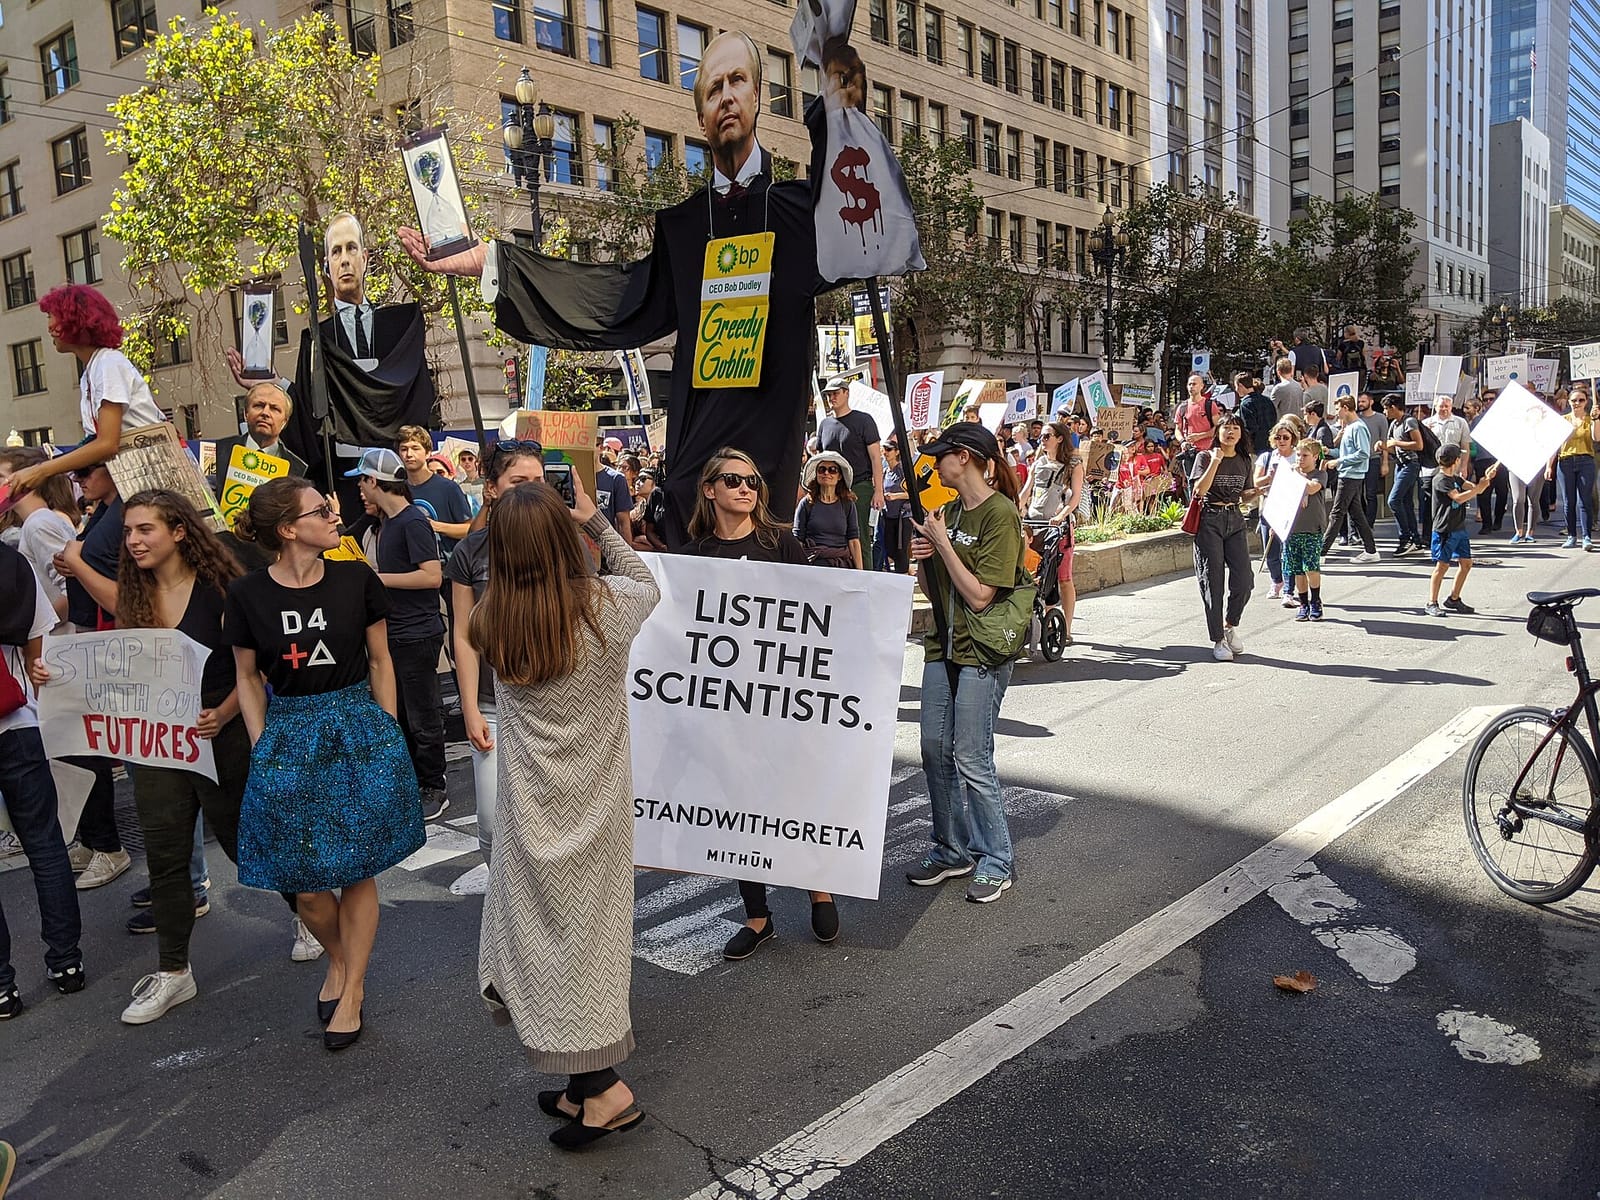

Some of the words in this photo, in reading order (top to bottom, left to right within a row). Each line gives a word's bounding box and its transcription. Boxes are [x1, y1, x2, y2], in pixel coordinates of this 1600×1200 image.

[739, 245, 760, 269] bp
[708, 284, 723, 295] CEO
[724, 282, 738, 293] Bob
[738, 279, 762, 292] Dudley
[701, 302, 764, 353] Greedy
[699, 341, 756, 382] Goblin
[528, 411, 591, 429] GLOBAL
[1097, 409, 1125, 421] MAKE
[518, 427, 590, 447] WARMING
[233, 471, 247, 480] CEO
[246, 475, 258, 484] Bob
[260, 458, 278, 475] bp
[695, 589, 832, 637] LISTEN
[45, 636, 143, 688] STOP
[685, 631, 740, 668] TO
[753, 639, 833, 681] THE
[85, 683, 150, 713] WITH
[630, 668, 873, 731] SCIENTISTS.
[82, 713, 200, 763] FUTURES
[706, 849, 773, 870] MITHŪN
